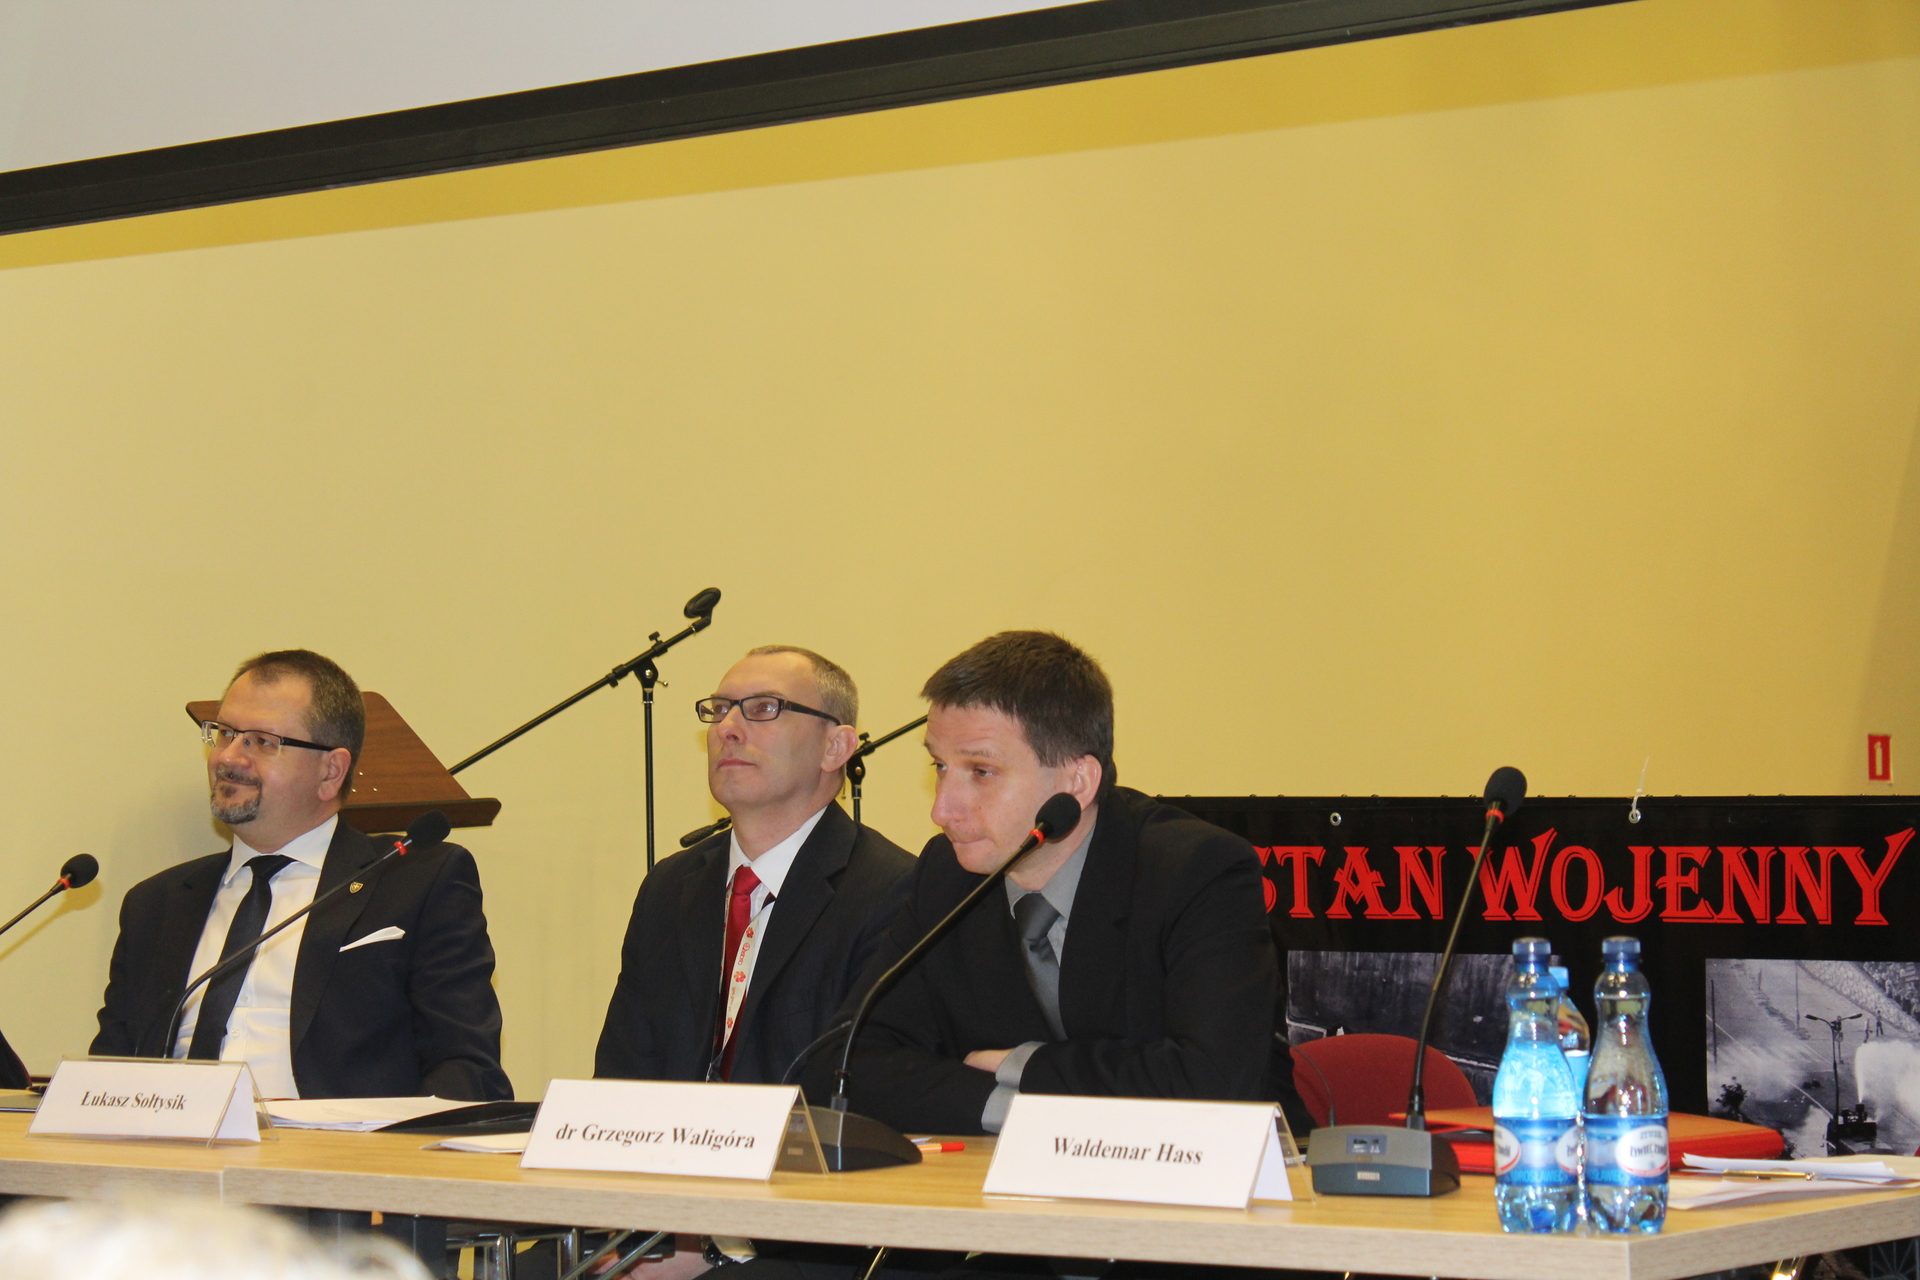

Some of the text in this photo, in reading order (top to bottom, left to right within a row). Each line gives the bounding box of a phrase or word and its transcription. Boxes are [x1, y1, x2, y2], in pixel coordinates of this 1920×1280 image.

[1466, 828, 1916, 925] WOJENNY
[81, 1091, 187, 1113] Łukasz Sołtysik
[555, 1123, 755, 1151] dr Grzegorz Waligóra
[1053, 1136, 1204, 1166] Waldemar Hass
